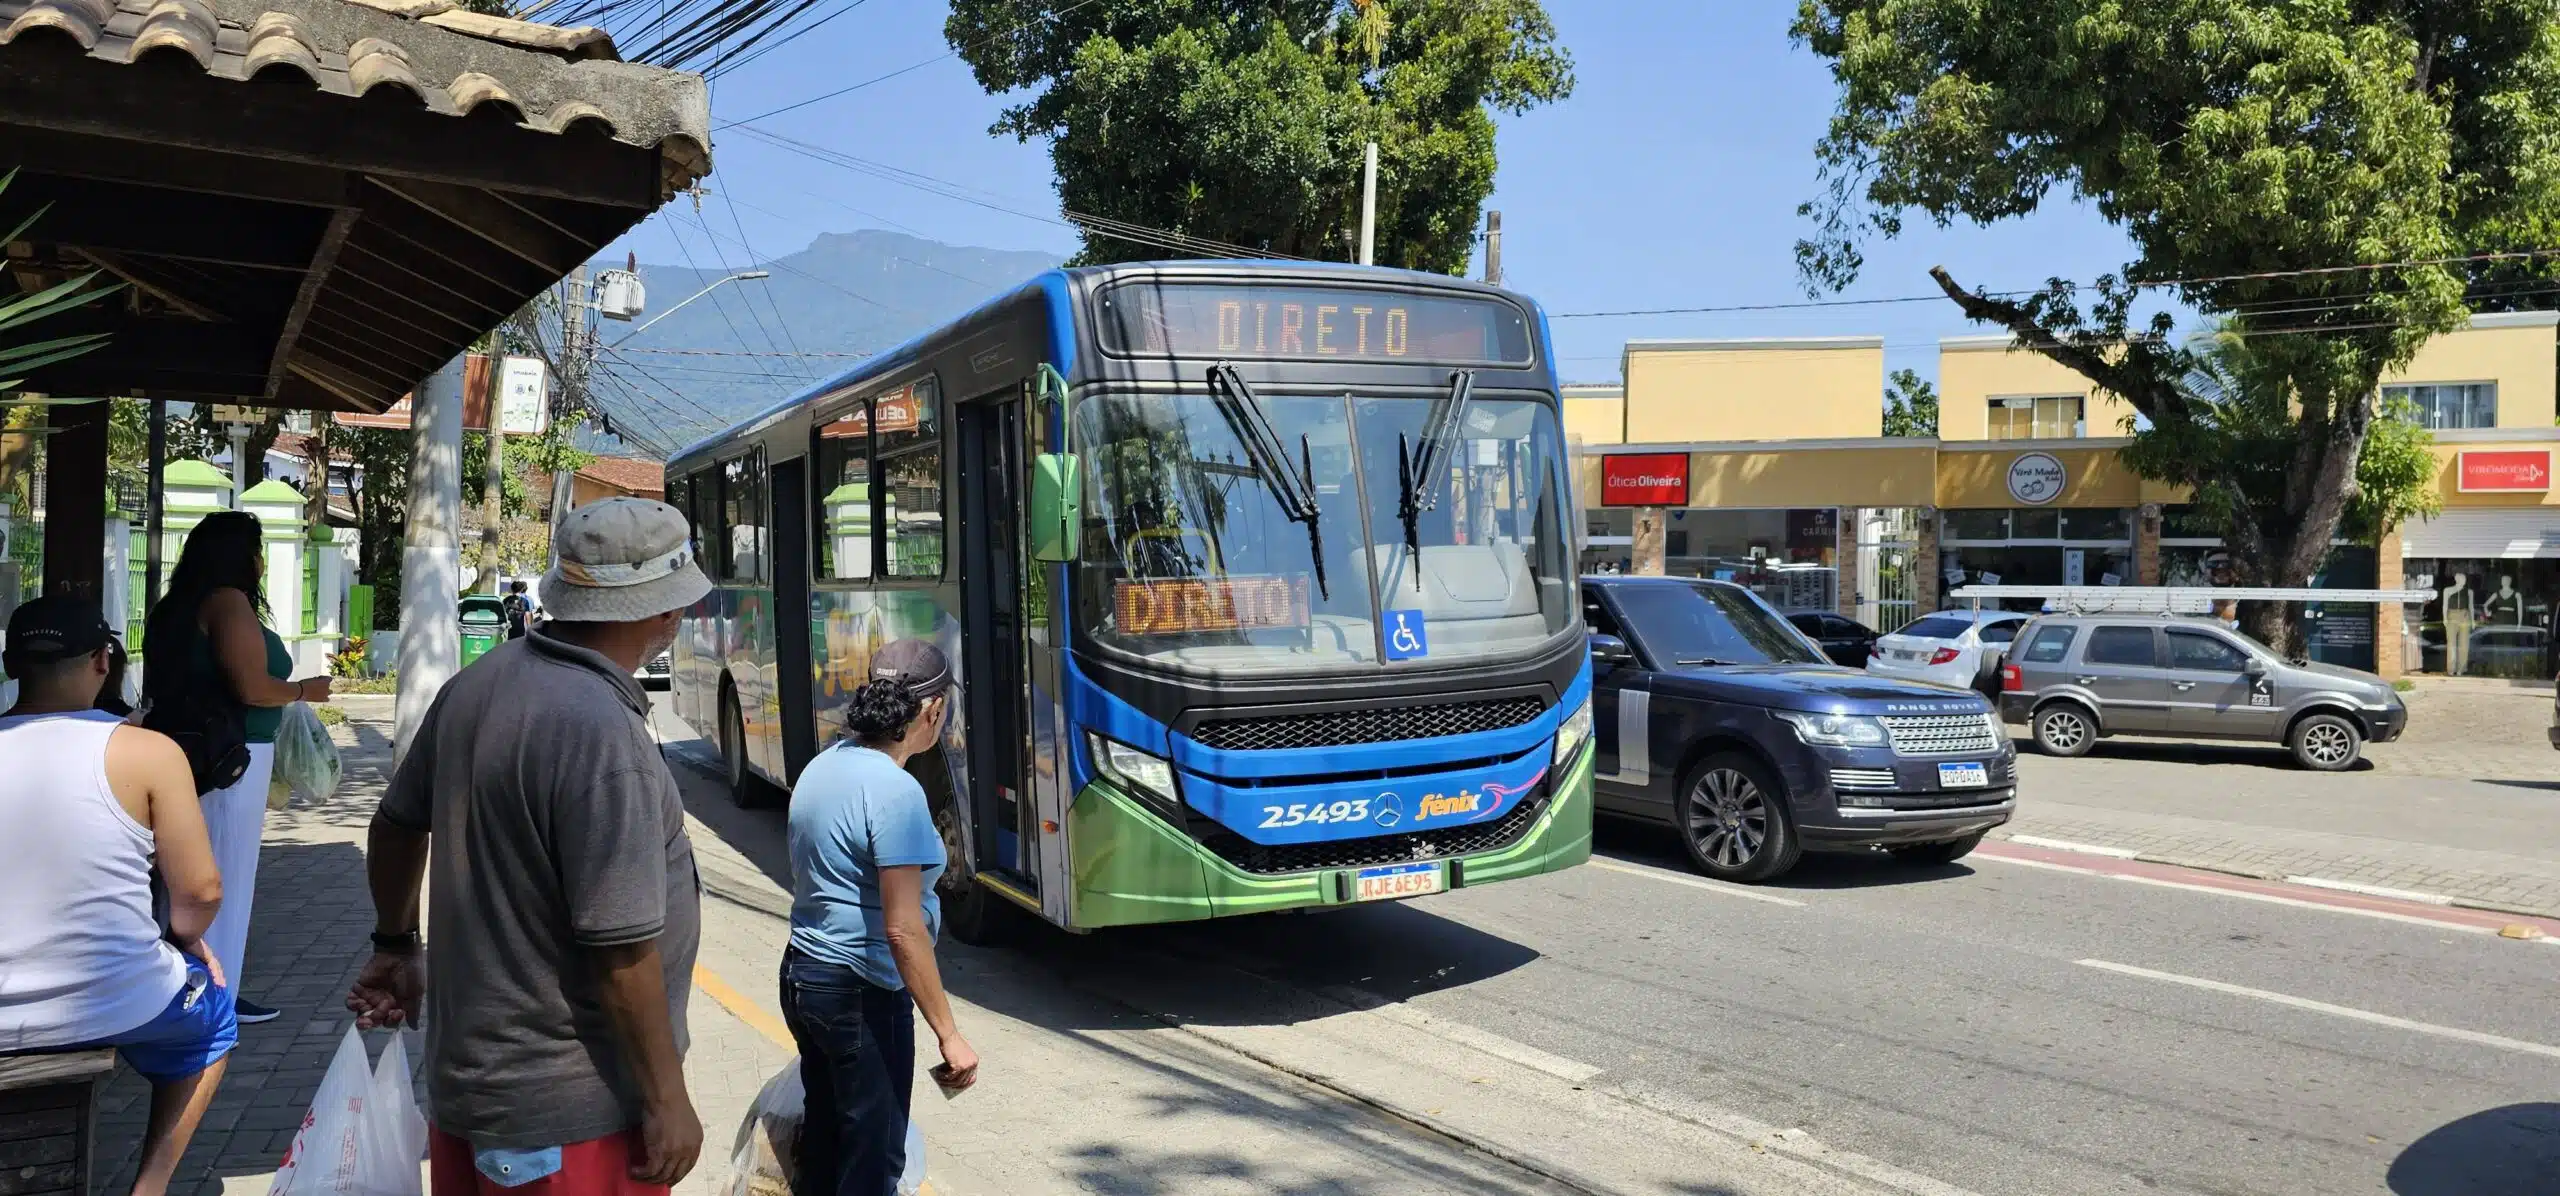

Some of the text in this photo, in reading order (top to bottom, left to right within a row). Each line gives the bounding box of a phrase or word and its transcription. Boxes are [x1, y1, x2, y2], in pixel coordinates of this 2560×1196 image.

[1217, 301, 1408, 356] DIRETO
[1608, 472, 1681, 488] Ótica Oliveira
[1128, 580, 1289, 632] DIRETO
[1258, 799, 1371, 829] 25493
[1415, 790, 1481, 822] fênix
[1364, 873, 1432, 897] RJE6E95
